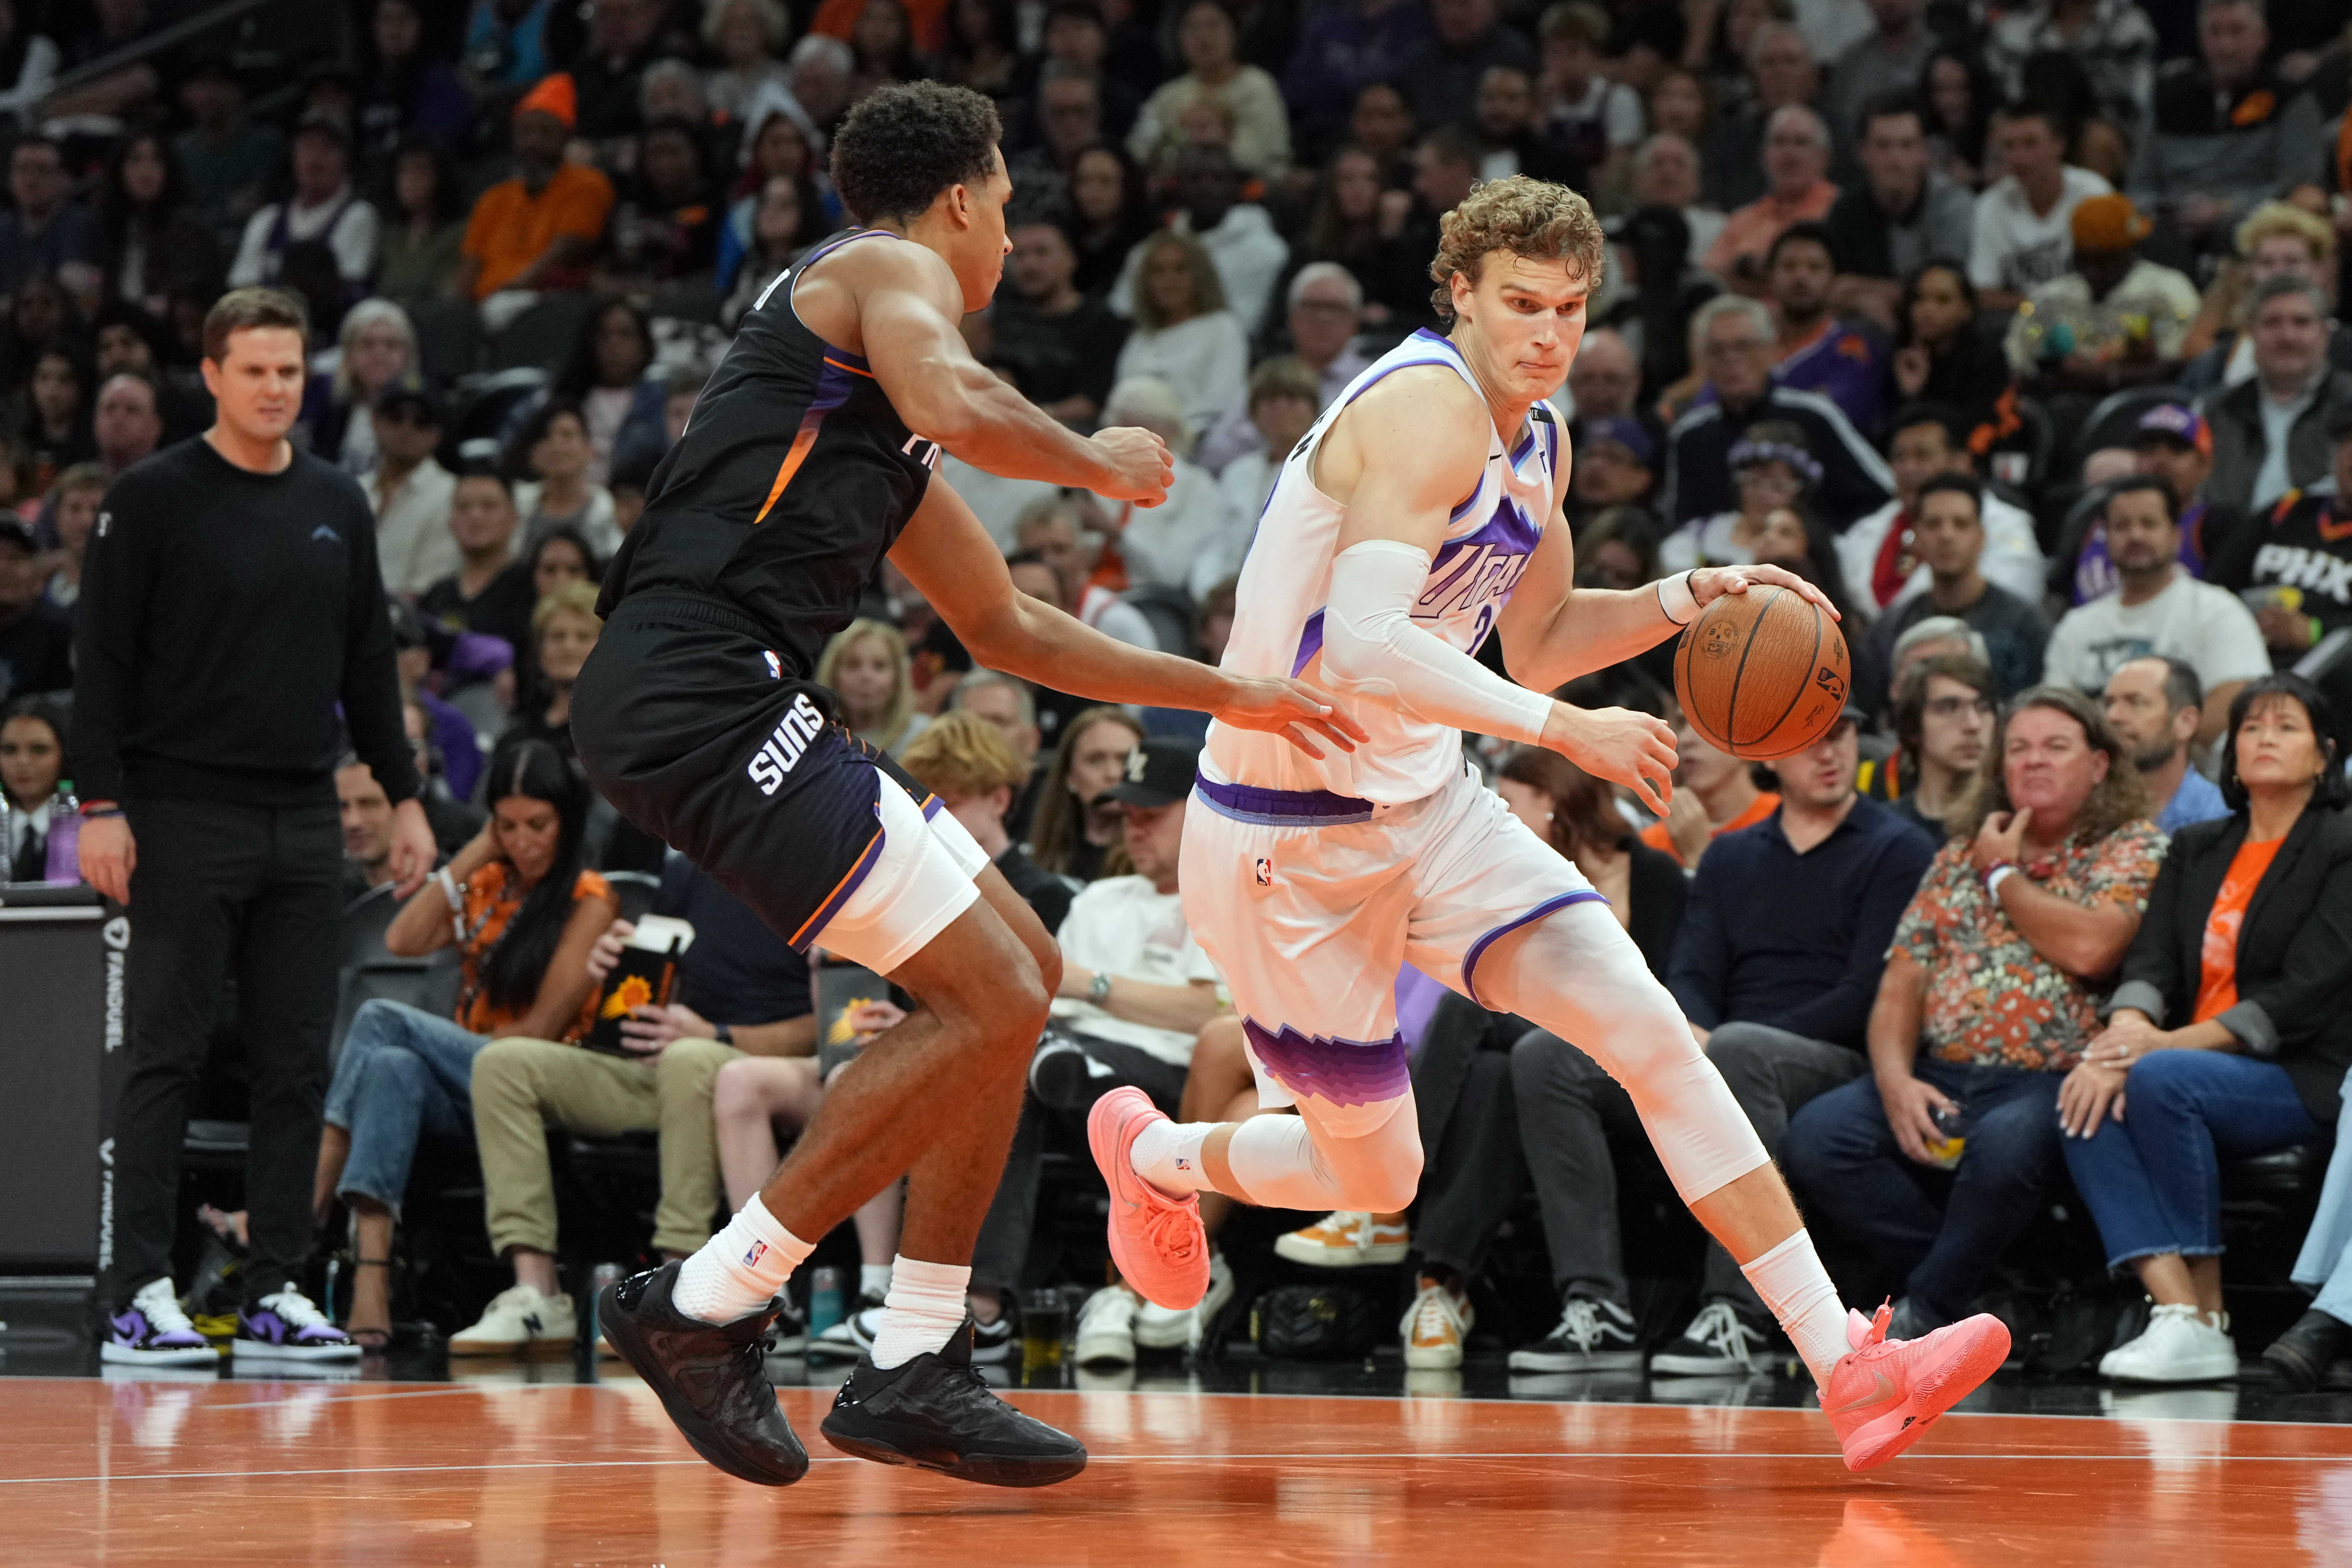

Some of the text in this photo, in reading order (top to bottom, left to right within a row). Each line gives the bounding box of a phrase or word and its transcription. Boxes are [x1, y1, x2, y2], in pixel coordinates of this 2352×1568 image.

[2252, 543, 2352, 603] PHX
[748, 693, 824, 795] SUNS
[105, 951, 124, 1053] FANDUEL
